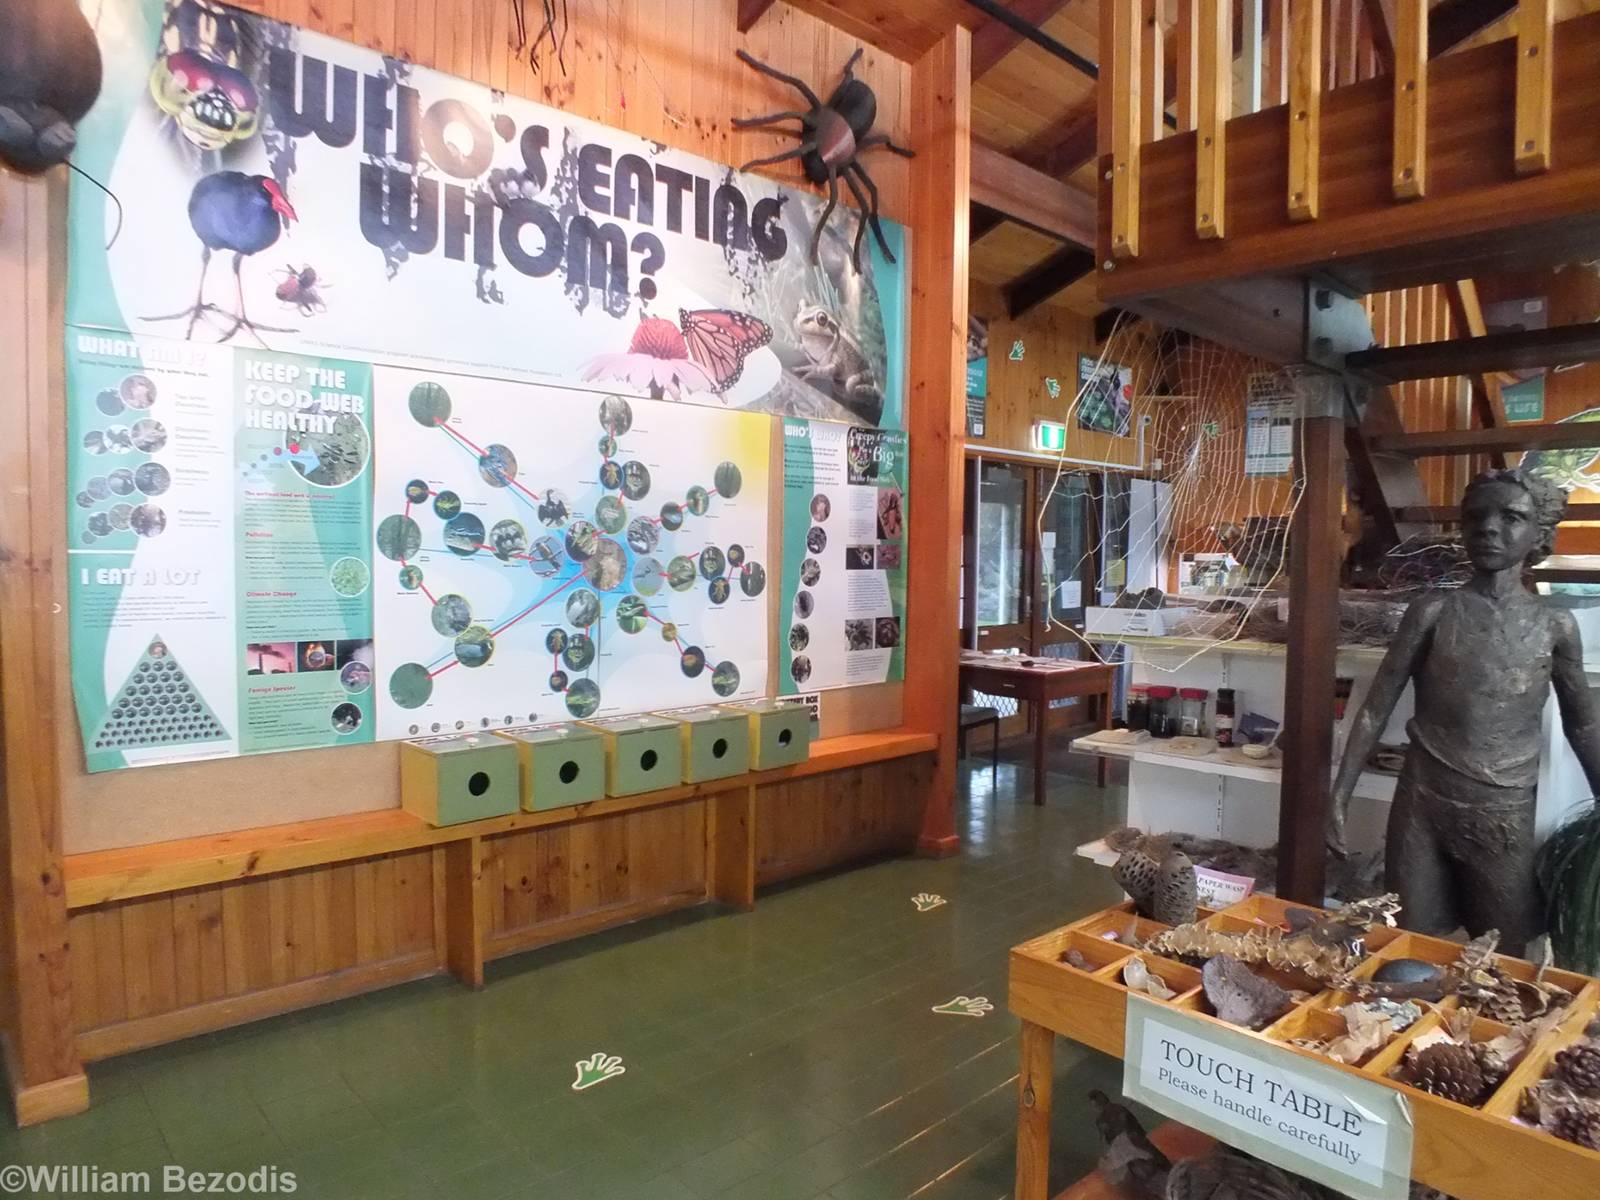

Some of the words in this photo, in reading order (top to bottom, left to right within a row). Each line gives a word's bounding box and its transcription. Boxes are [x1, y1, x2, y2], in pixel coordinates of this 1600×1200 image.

[268, 50, 549, 193] WHO'S
[577, 143, 788, 263] EATING
[360, 161, 665, 304] WHOM?
[78, 335, 138, 358] WHAT
[245, 360, 300, 384] KEEP
[304, 367, 346, 390] THE
[245, 384, 314, 410] FOOD
[319, 391, 365, 414] WEB
[245, 408, 338, 434] HEALTHY
[873, 445, 895, 466] Big
[96, 568, 135, 586] EAT
[164, 570, 201, 586] LOT
[1199, 877, 1223, 889] PAPER
[1223, 882, 1245, 892] WASP
[1160, 1039, 1255, 1095] TOUCH
[1263, 1079, 1363, 1137] TABLE
[1158, 1067, 1208, 1100] Please
[1213, 1089, 1273, 1127] handle
[1278, 1120, 1361, 1165] carefully
